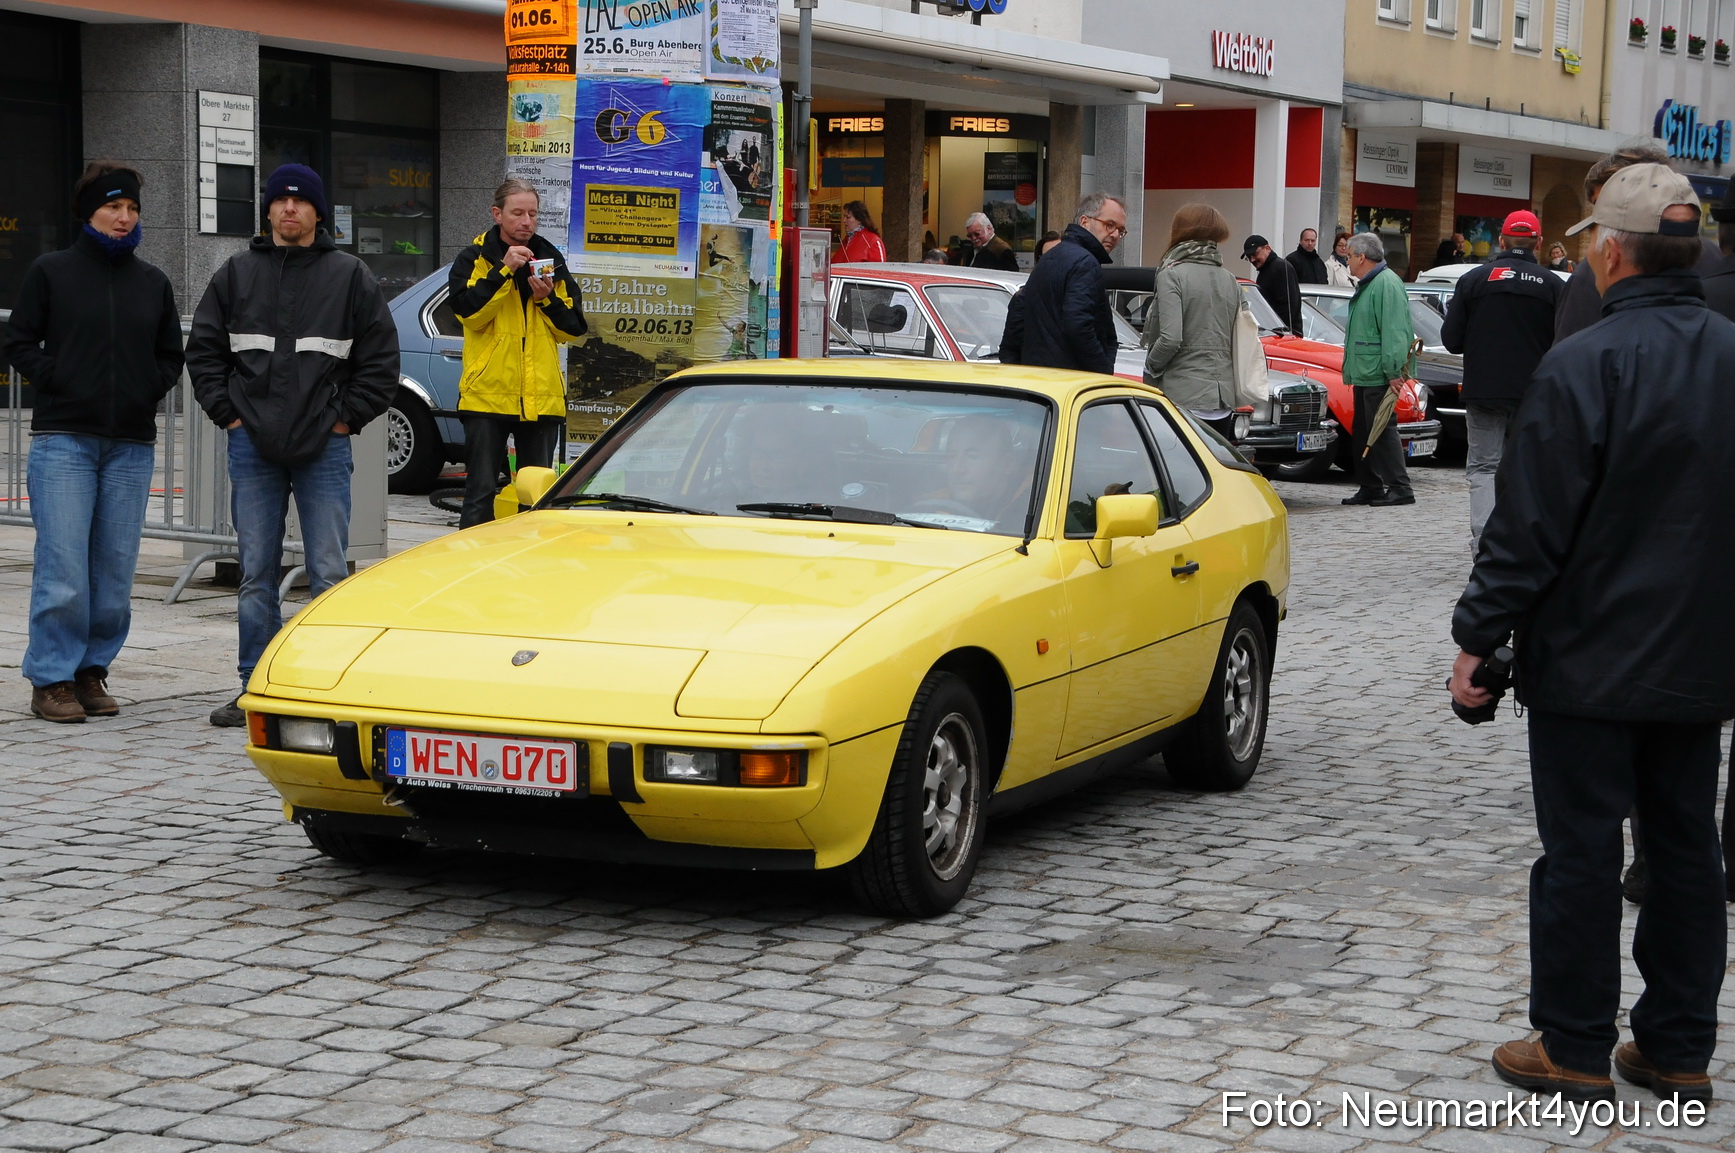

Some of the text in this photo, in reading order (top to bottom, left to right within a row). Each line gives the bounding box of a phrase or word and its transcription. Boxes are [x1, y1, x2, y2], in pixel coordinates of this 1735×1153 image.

[511, 9, 557, 29] 01.06.
[628, 1, 671, 27] OPEN
[677, 0, 701, 19] AIR
[583, 37, 631, 54] 25.6.
[631, 39, 654, 50] Burg
[630, 48, 673, 57] Open Air
[1212, 29, 1275, 77] Weltbild
[545, 62, 570, 73] 7-14h
[201, 98, 252, 111] Obere Marktstr.
[714, 91, 747, 102] Konzert
[222, 113, 231, 122] 27
[828, 117, 885, 132] FRIES
[950, 116, 1010, 132] FRIES
[594, 108, 667, 145] G6
[523, 141, 529, 152] 2.
[530, 141, 546, 153] Juni
[548, 141, 571, 154] 2013
[596, 164, 606, 172] für
[606, 166, 633, 174] Jugend,
[634, 168, 659, 177] Bildung
[674, 170, 694, 178] Kultur
[590, 192, 674, 208] Metal Night
[618, 236, 640, 244] Juni,
[642, 236, 654, 244] 20
[656, 237, 673, 245] Uhr
[1520, 272, 1544, 284] line
[607, 278, 668, 296] Jahre
[582, 298, 694, 316] ulztalbahn
[614, 318, 694, 335] 02.06.13
[393, 757, 401, 768] D
[411, 736, 567, 785] WEN 070
[406, 778, 426, 787] Auto
[428, 780, 451, 790] Weiss
[456, 782, 504, 794] Tirschenreuth
